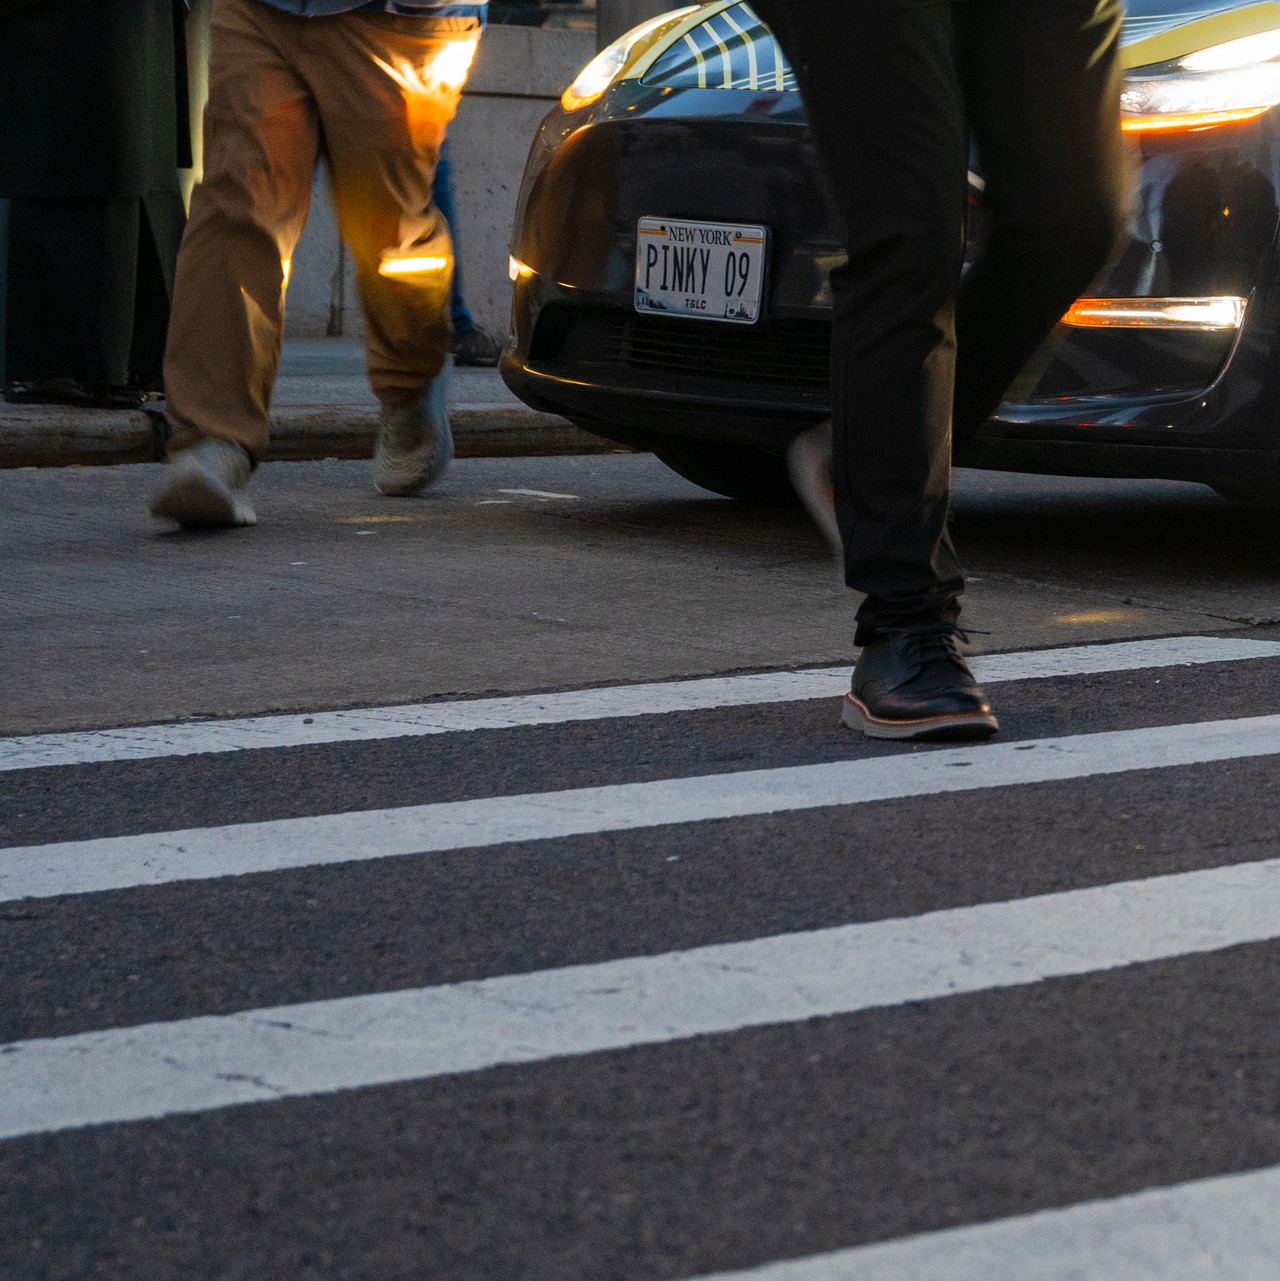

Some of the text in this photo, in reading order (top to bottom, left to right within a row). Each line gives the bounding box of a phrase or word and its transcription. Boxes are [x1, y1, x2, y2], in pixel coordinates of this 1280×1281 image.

[669, 226, 732, 246] NEW YORK
[645, 243, 750, 297] PINKY 09
